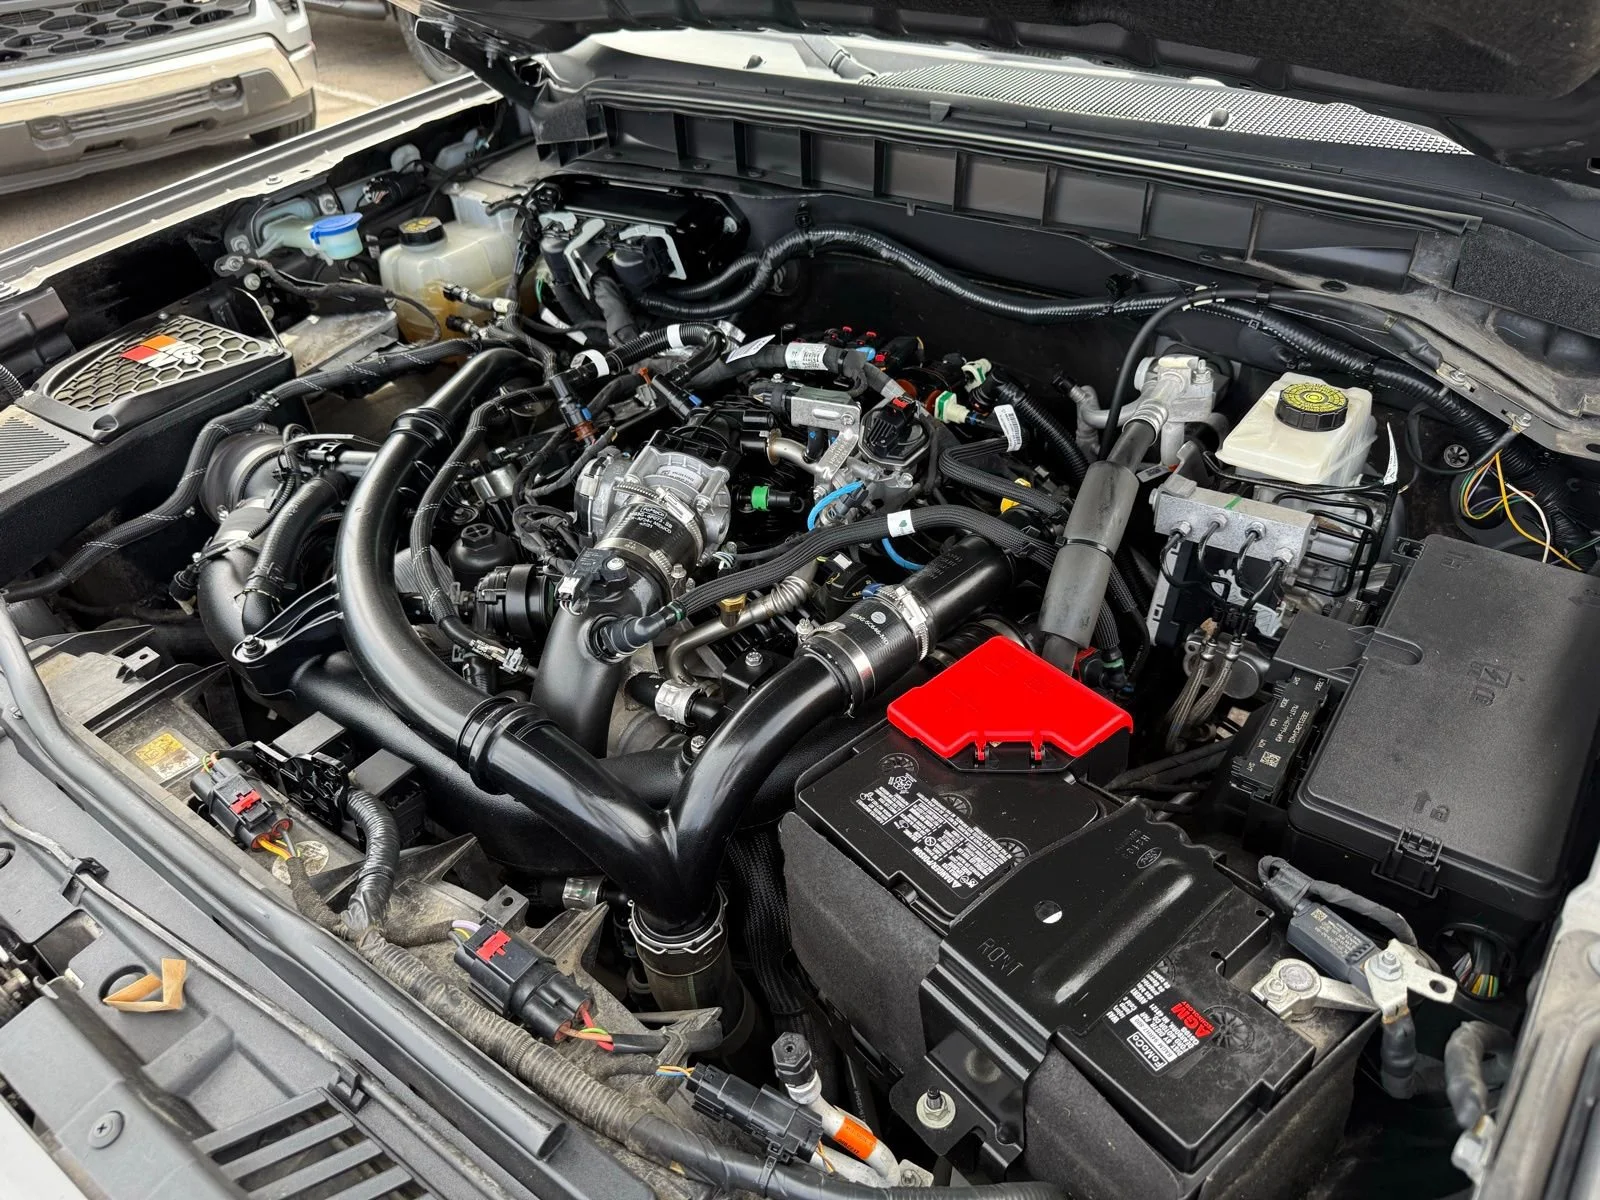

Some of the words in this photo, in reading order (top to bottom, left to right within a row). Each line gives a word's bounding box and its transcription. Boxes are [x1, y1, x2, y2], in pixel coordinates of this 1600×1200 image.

[135, 338, 202, 366] K&N
[1159, 1022, 1177, 1040] MOTOR
[1171, 1003, 1211, 1037] AGM
[1182, 1001, 1214, 1032] TECHNOLOGY
[1132, 1033, 1164, 1069] FoMoCo
[1174, 1038, 1190, 1052] FORD
